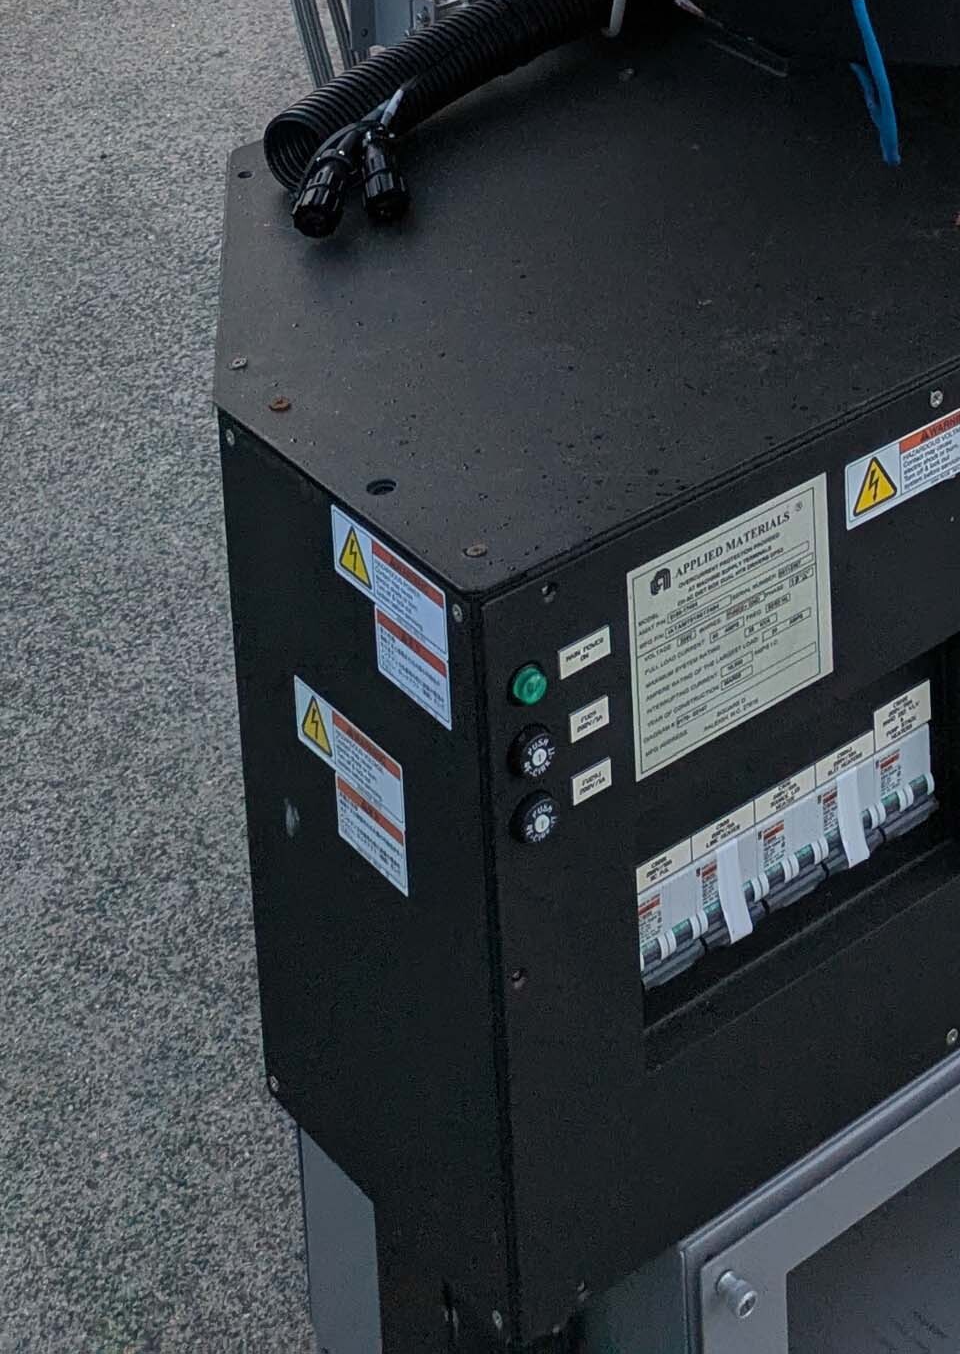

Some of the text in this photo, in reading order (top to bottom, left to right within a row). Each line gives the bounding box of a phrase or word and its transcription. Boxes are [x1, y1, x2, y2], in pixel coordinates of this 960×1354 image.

[903, 437, 942, 462] HAZARDOUS
[903, 454, 923, 469] Contact
[937, 439, 952, 452] cause
[903, 462, 922, 476] electric
[923, 453, 939, 465] shock
[675, 511, 790, 579] APPLIED MATERIALS
[722, 561, 742, 576] SUPPLY
[743, 545, 772, 565] TERMINALS
[678, 532, 780, 590] OVERCURRENT PROTECTION PROVIDED
[647, 672, 718, 716] INTERRUPTING CURRENT
